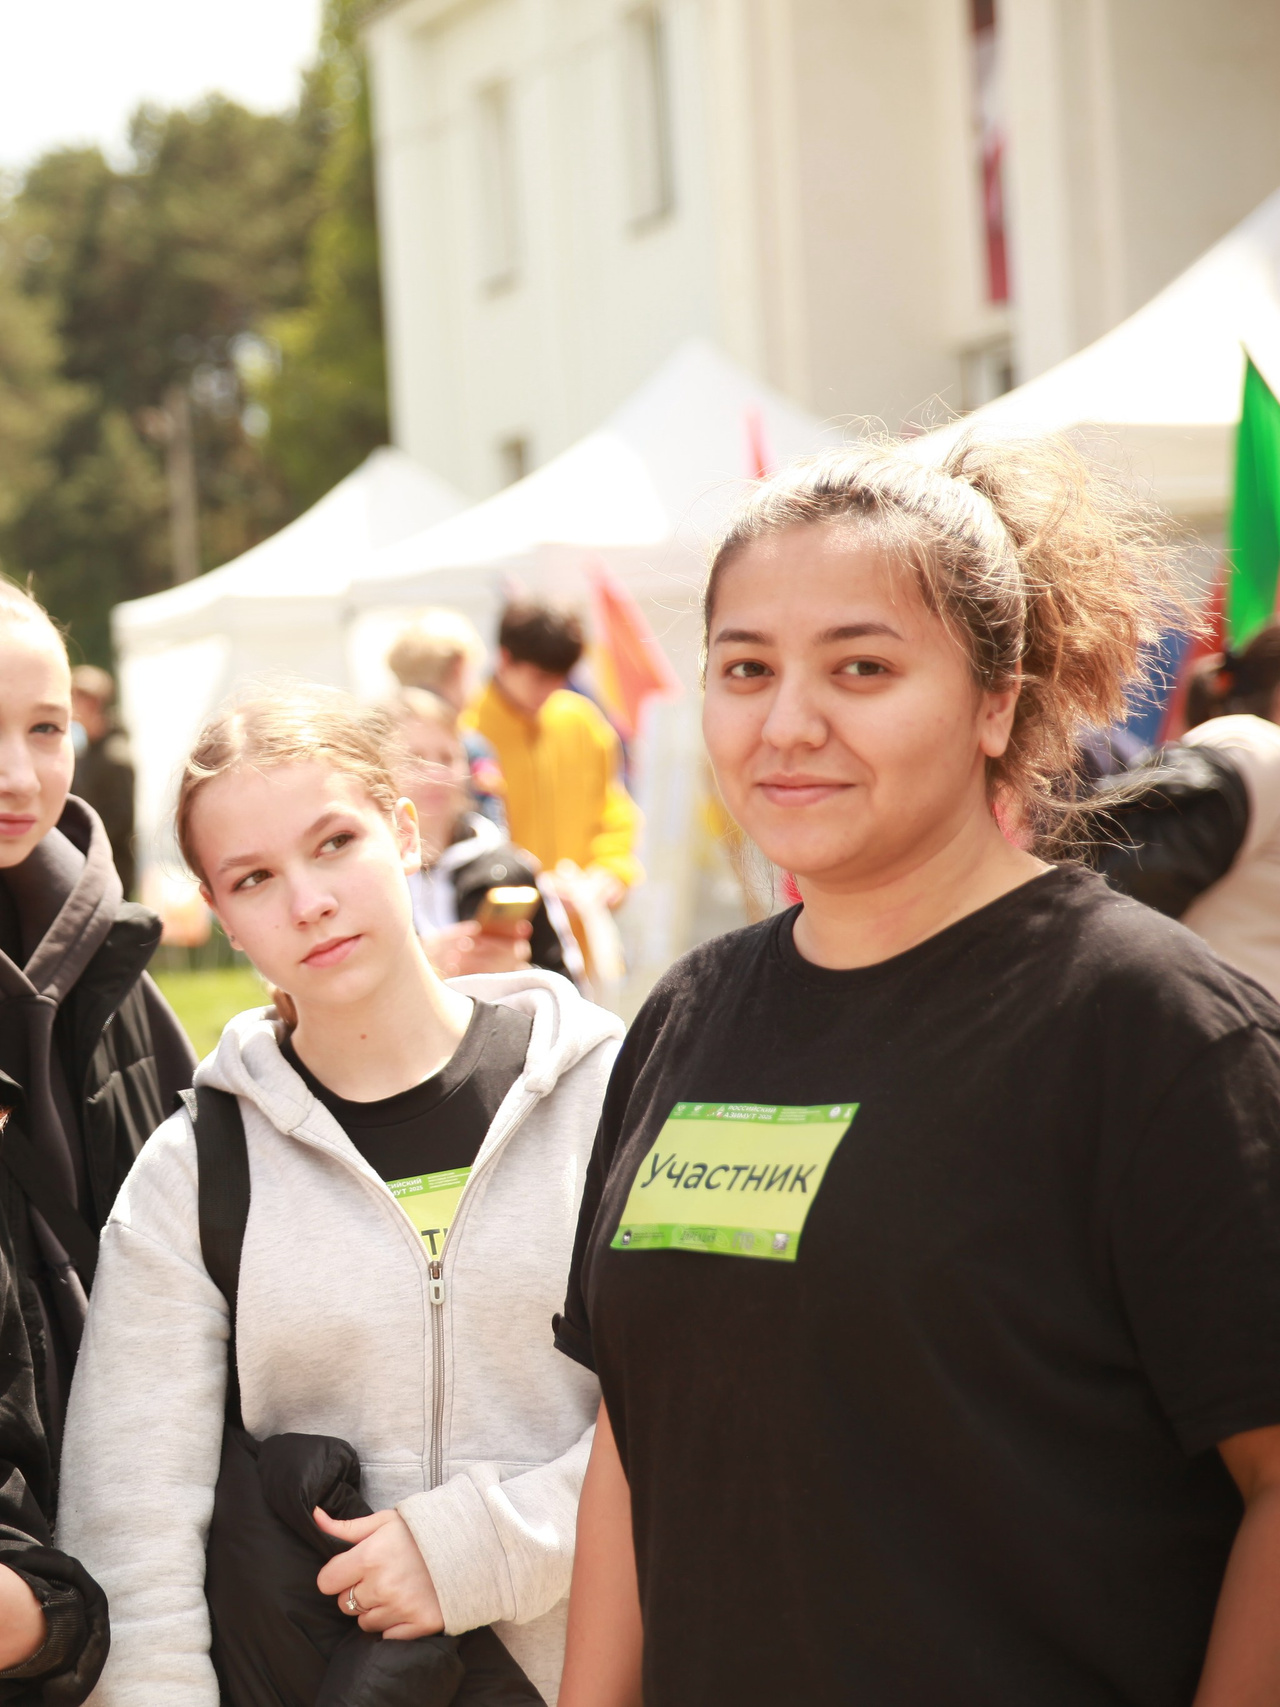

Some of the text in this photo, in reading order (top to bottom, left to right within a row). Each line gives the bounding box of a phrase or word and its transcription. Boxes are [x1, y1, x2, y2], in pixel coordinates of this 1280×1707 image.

[727, 1105, 777, 1113] РОССИЙСКИЙ
[723, 1111, 756, 1120] АЗИМУТ
[640, 1152, 818, 1194] Участник
